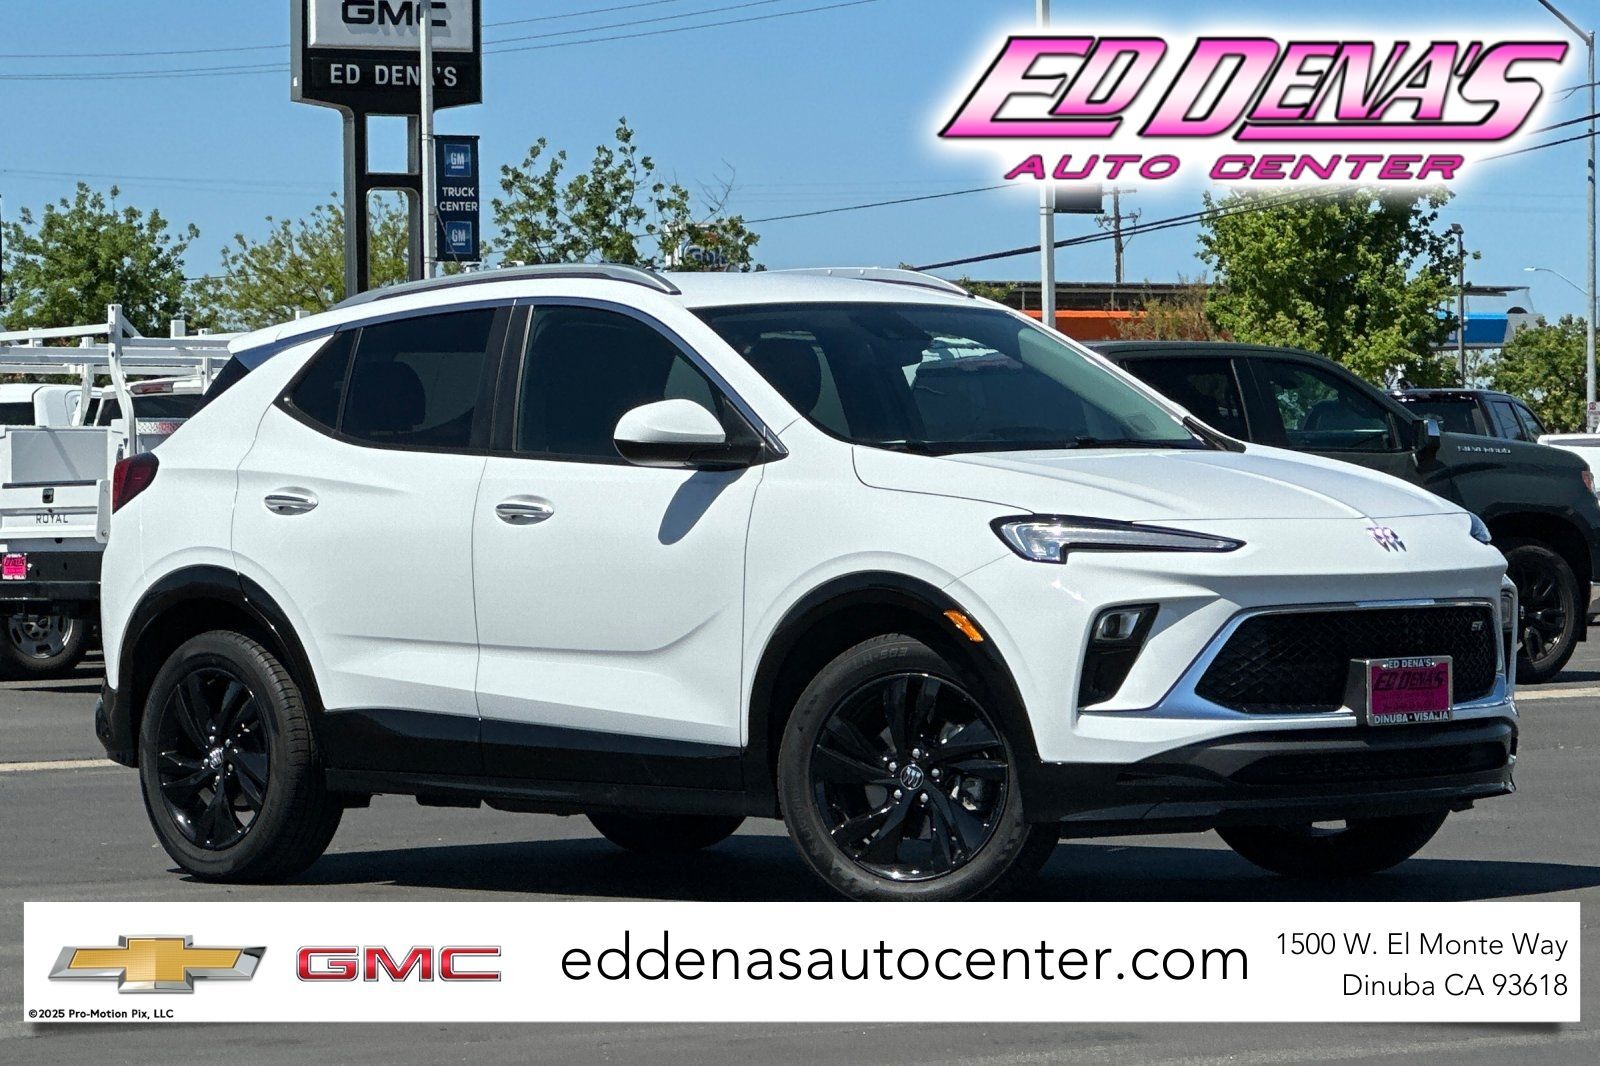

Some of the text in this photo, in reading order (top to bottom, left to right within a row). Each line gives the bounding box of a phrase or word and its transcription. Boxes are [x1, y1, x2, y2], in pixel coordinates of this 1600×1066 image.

[341, 0, 446, 27] GMC
[330, 63, 457, 87] ED DEN'S
[450, 152, 465, 165] GM
[442, 187, 475, 197] TRUCK
[439, 201, 478, 212] CENTER
[451, 229, 466, 242] GM
[35, 513, 69, 524] ROYAL
[1388, 658, 1432, 669] ED DENA'S
[1374, 710, 1449, 724] DINUBA VISALIA
